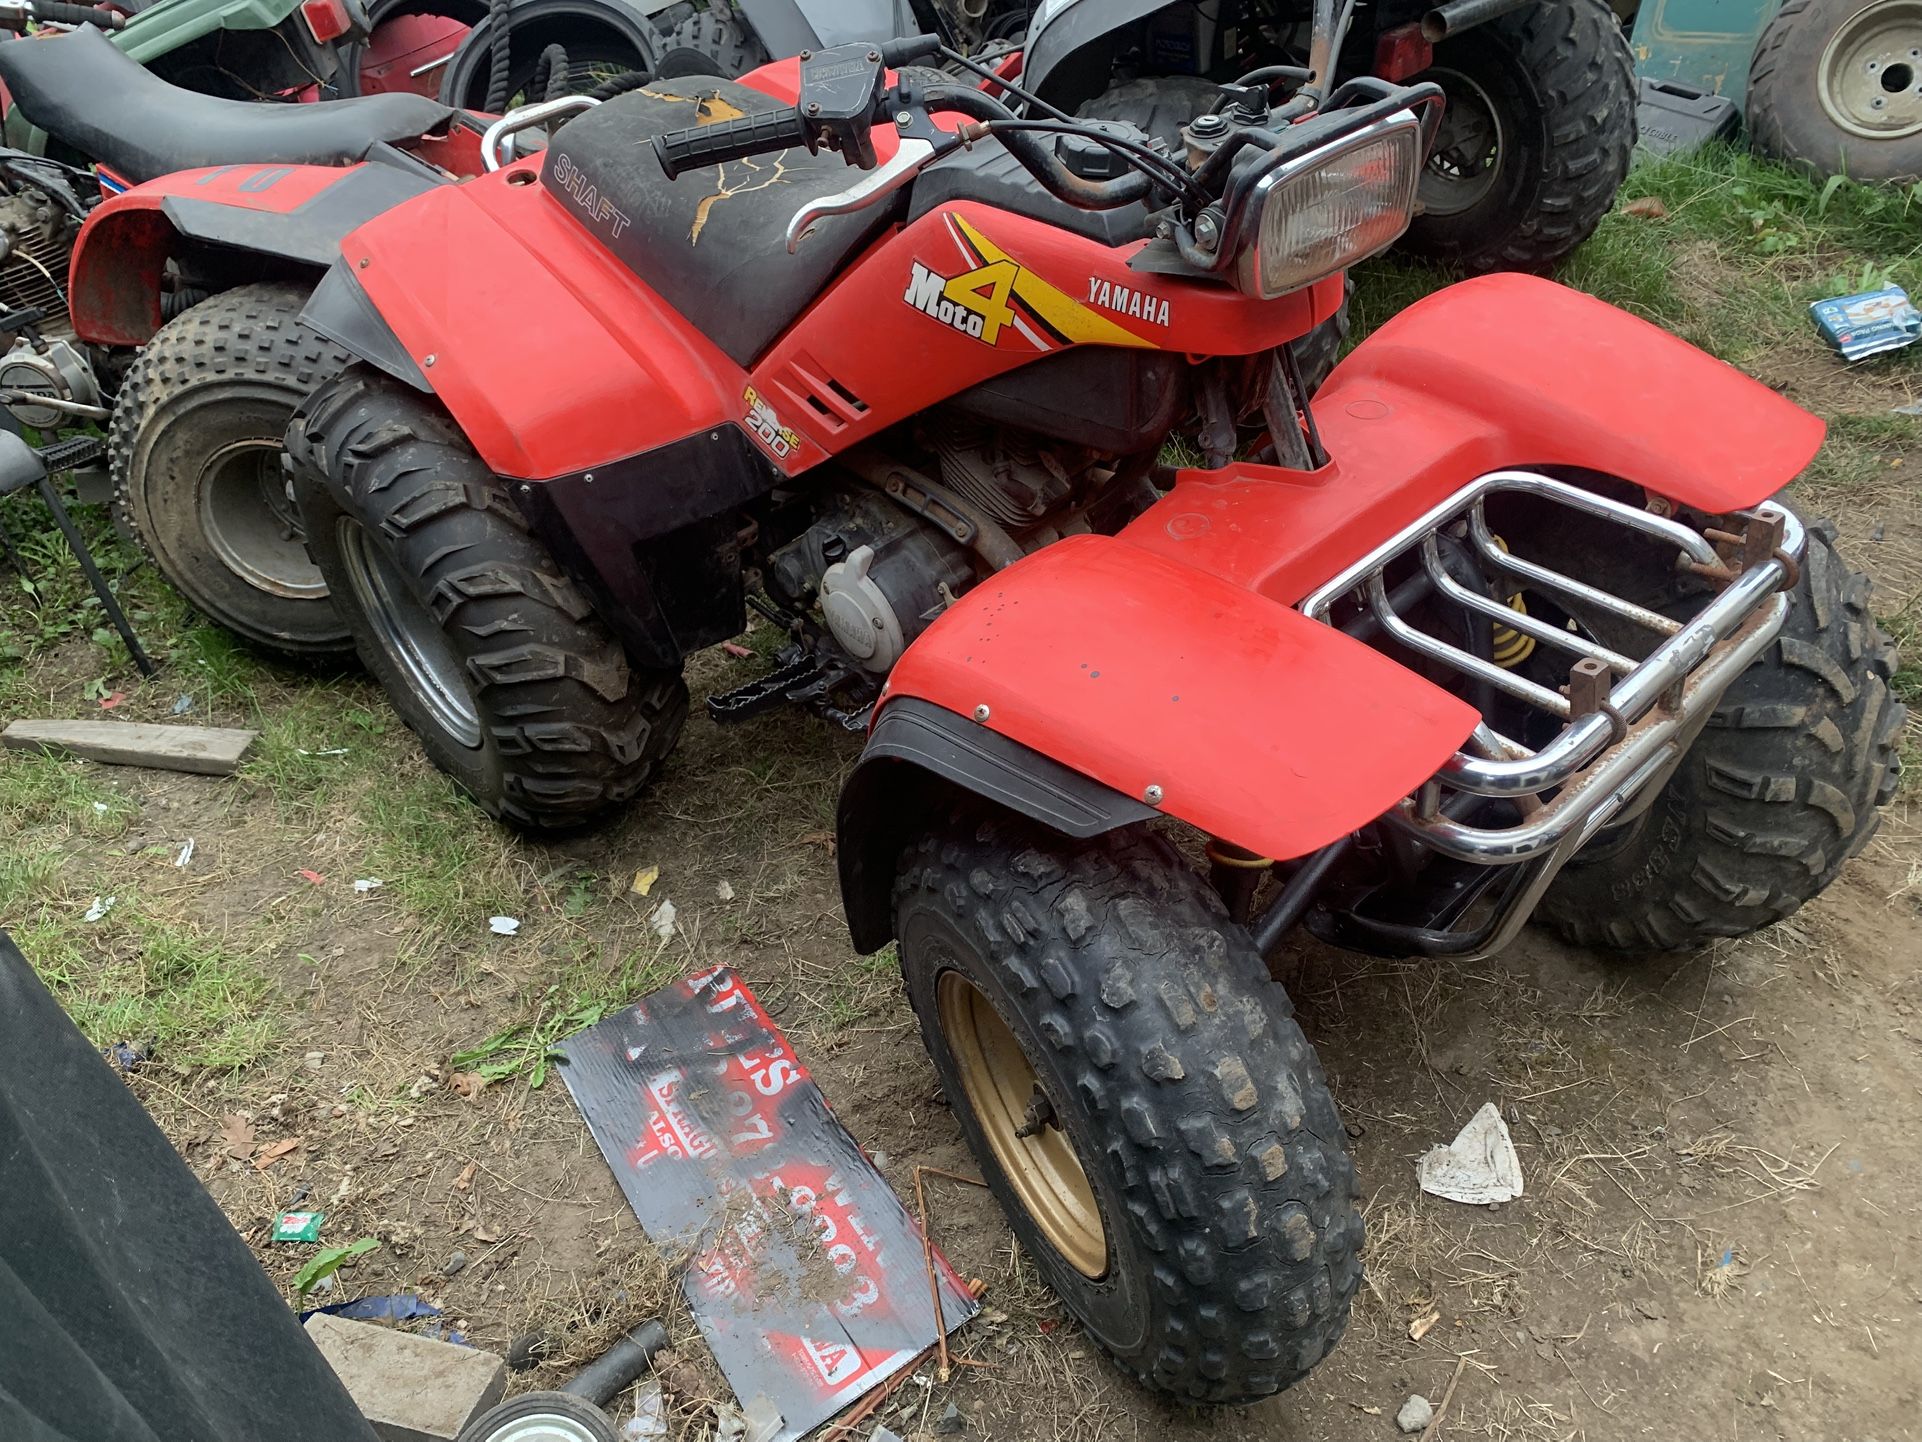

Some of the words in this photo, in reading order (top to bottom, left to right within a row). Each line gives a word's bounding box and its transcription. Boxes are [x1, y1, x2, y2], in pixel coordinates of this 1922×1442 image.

[553, 153, 631, 239] SHAFT
[943, 259, 1020, 346] 4
[1088, 276, 1170, 327] YAMAHA
[743, 408, 791, 458] 200
[648, 1110, 683, 1161] ALSO
